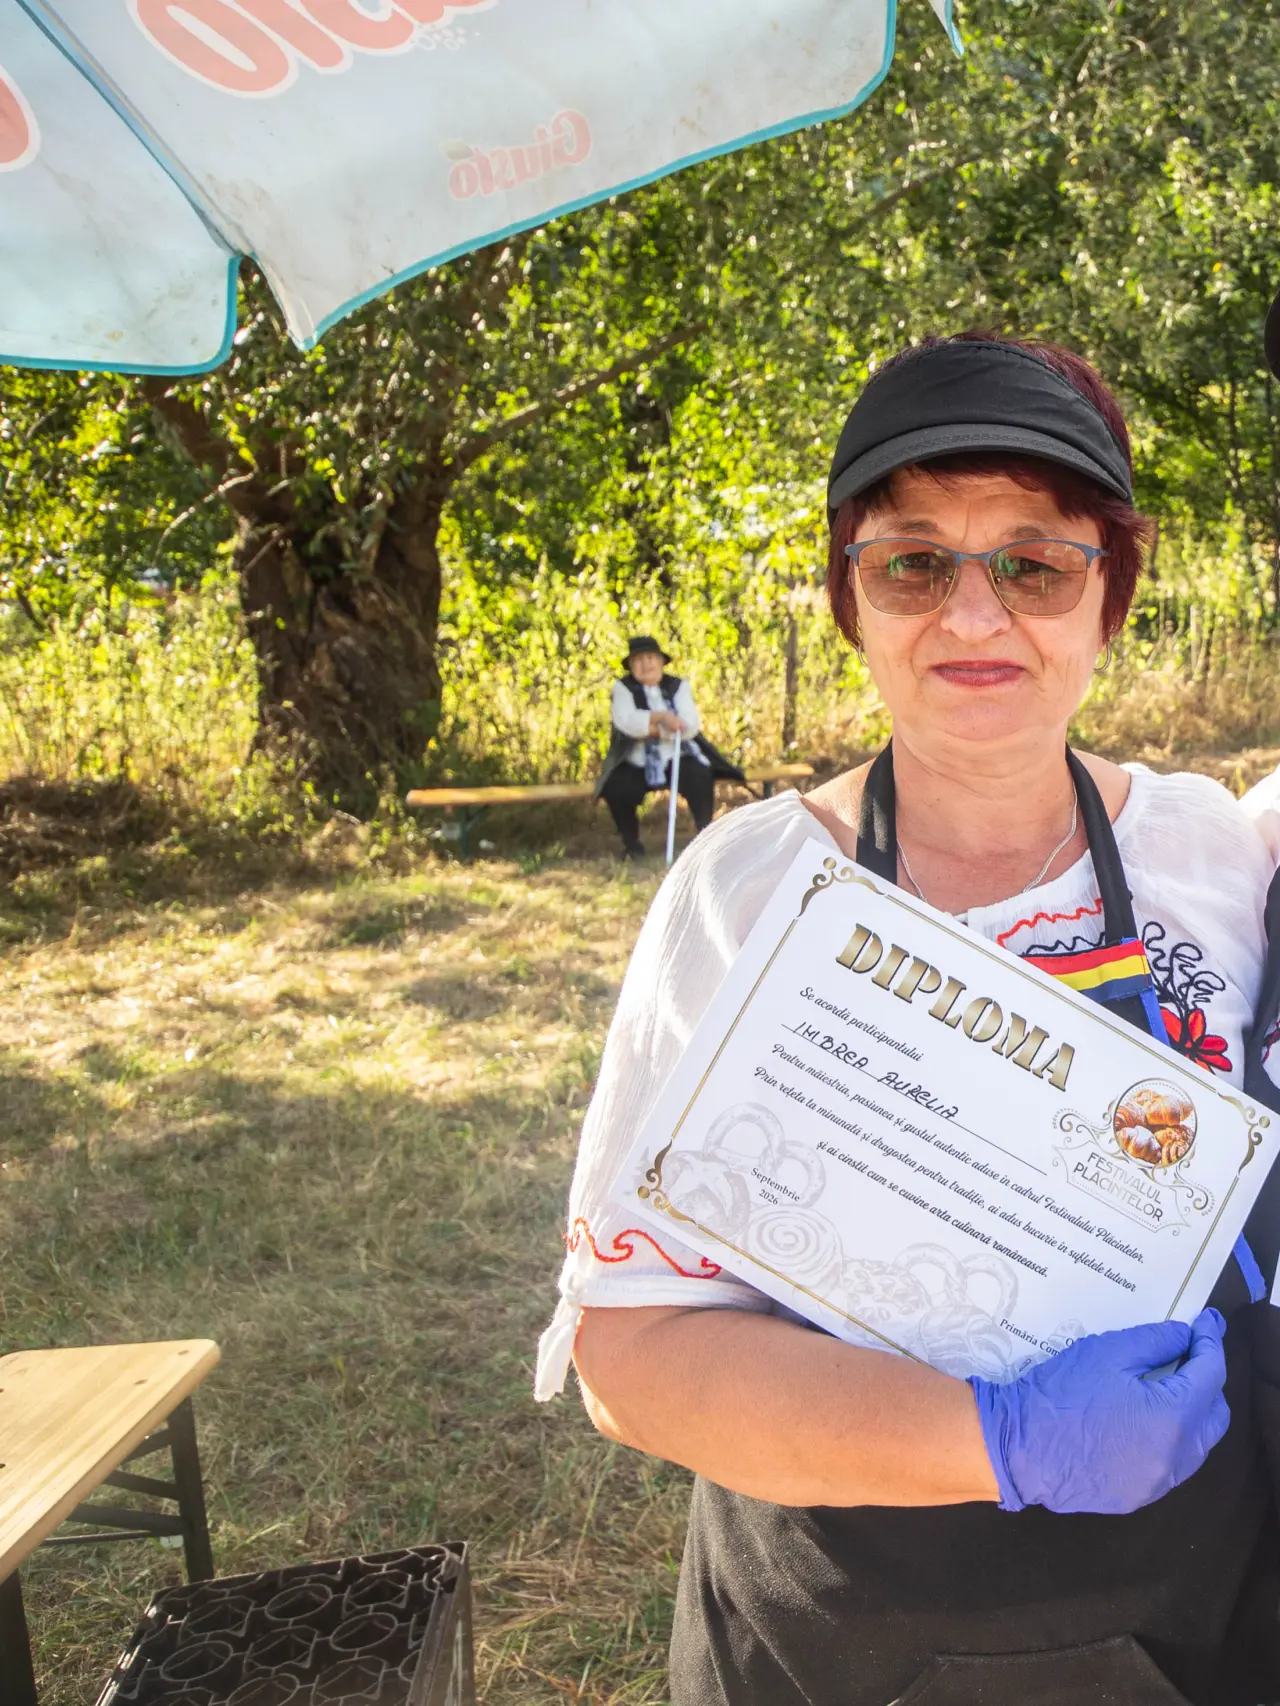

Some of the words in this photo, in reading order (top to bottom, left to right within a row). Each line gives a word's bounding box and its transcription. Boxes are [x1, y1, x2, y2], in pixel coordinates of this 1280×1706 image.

[799, 986, 815, 1001] Se
[814, 998, 852, 1021] acordă
[846, 1017, 925, 1062] participantului
[835, 923, 1076, 1093] DIPLOMA
[751, 1167, 800, 1202] Septembrie
[754, 1066, 778, 1087] Prin
[779, 1083, 806, 1104] rețeta
[816, 1107, 863, 1136] minunată
[860, 1133, 873, 1142] și
[870, 1137, 918, 1169] dragostea
[913, 1165, 949, 1187] pentru
[987, 1205, 1002, 1215] ai
[998, 1211, 1023, 1228] adus
[1022, 1221, 1058, 1248] bucurie
[1057, 1241, 1068, 1254] în
[1068, 1250, 1105, 1274] sufletele
[1104, 1268, 1137, 1293] tuturor
[772, 1044, 806, 1070] Pentru
[805, 1066, 850, 1098] măiestria,
[849, 1094, 895, 1121] pasiunea
[893, 1117, 907, 1132] și
[900, 1123, 938, 1143] gustul
[933, 1140, 972, 1165] autentic
[971, 1161, 1000, 1181] aduse
[999, 1175, 1011, 1187] în
[1010, 1183, 1046, 1204] cadrul
[1044, 1197, 1097, 1235] Festivalului
[1095, 1227, 1144, 1264] Plăcintelor.
[1087, 1153, 1161, 1204] FESTIVALUL
[759, 1189, 779, 1205] 2026
[816, 1141, 829, 1150] și
[826, 1147, 840, 1157] ai
[837, 1153, 869, 1174] cinstit
[866, 1170, 888, 1186] cum
[887, 1182, 899, 1192] se
[898, 1188, 930, 1210] cuvine
[929, 1206, 952, 1223] arta
[951, 1219, 992, 1245] culinară
[992, 1240, 1049, 1278] românească.
[1073, 1162, 1163, 1222] PLĂCINTELOR
[1000, 1318, 1038, 1346] Primăria
[1039, 1341, 1064, 1360] Com
